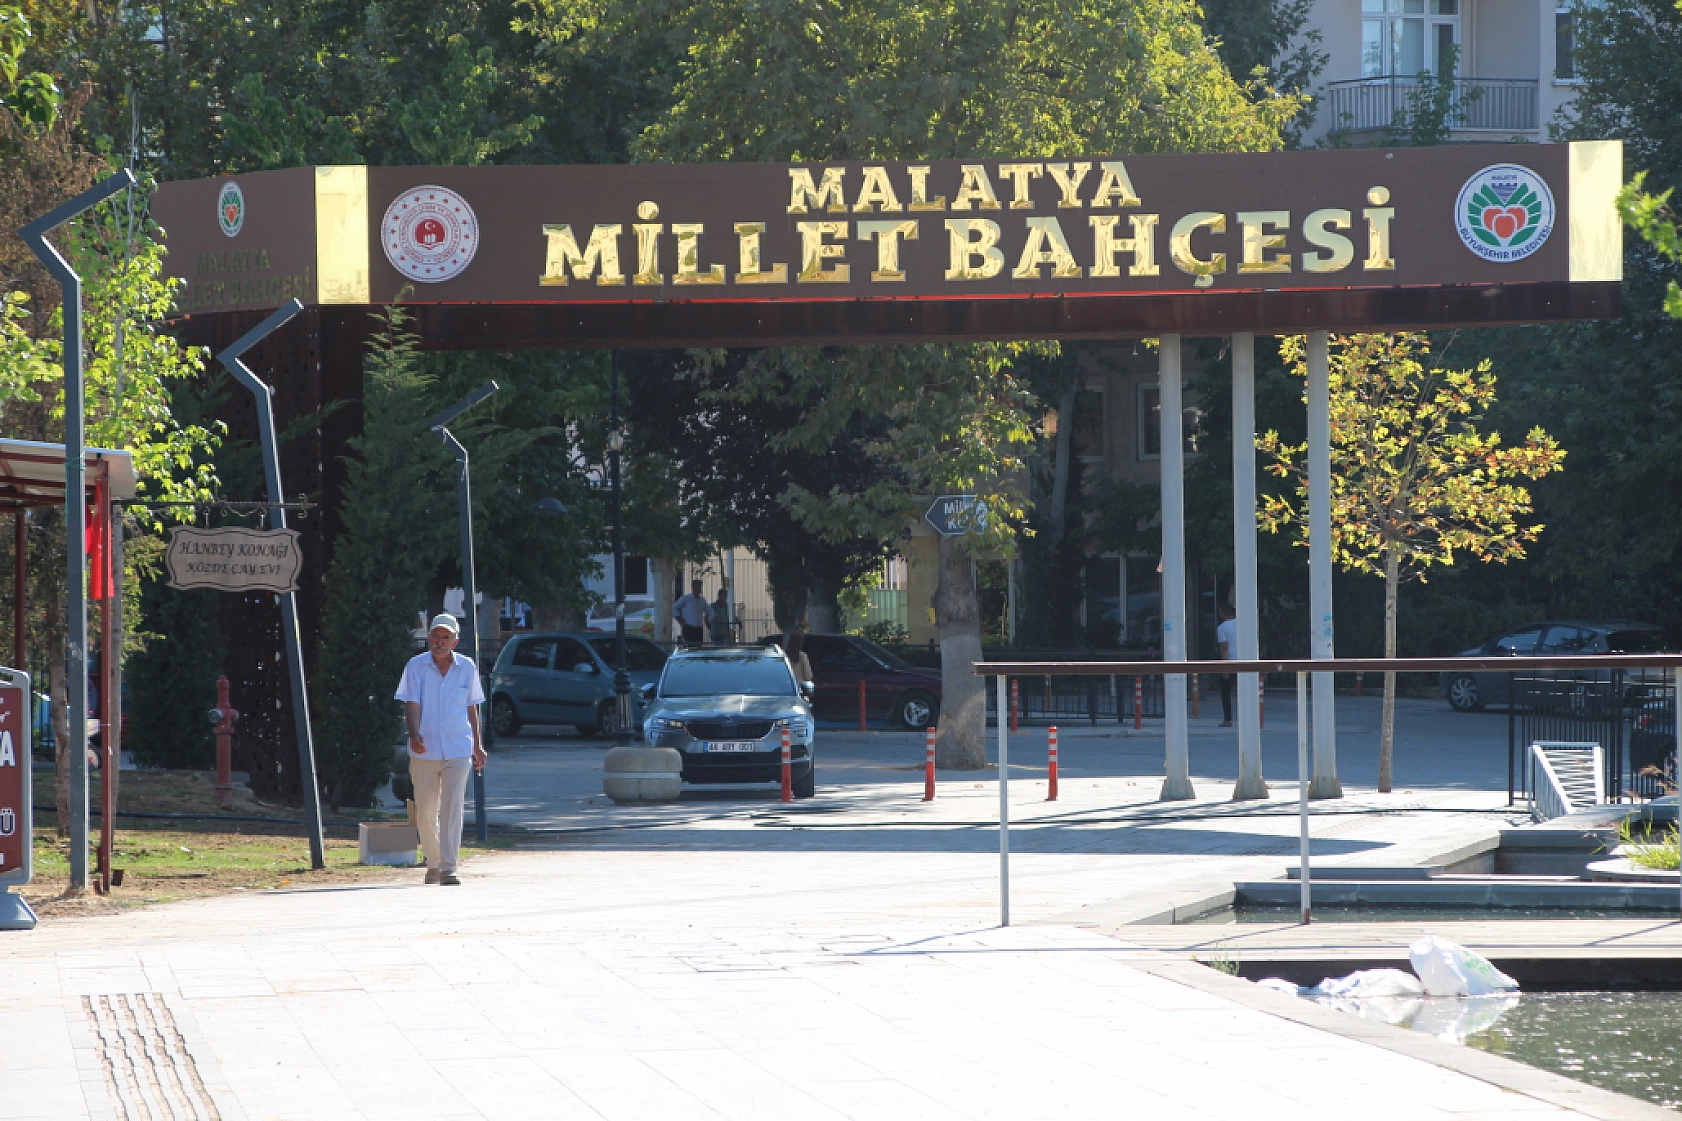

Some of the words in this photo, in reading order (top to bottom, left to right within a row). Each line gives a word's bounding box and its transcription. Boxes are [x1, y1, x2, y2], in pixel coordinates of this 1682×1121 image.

[787, 161, 1141, 214] MALATYA
[539, 201, 919, 286] MİLLET
[944, 185, 1396, 288] BAHÇESİ
[195, 249, 271, 274] MALATYA
[228, 265, 312, 305] BAHÇESİ
[178, 541, 235, 559] HANBEY
